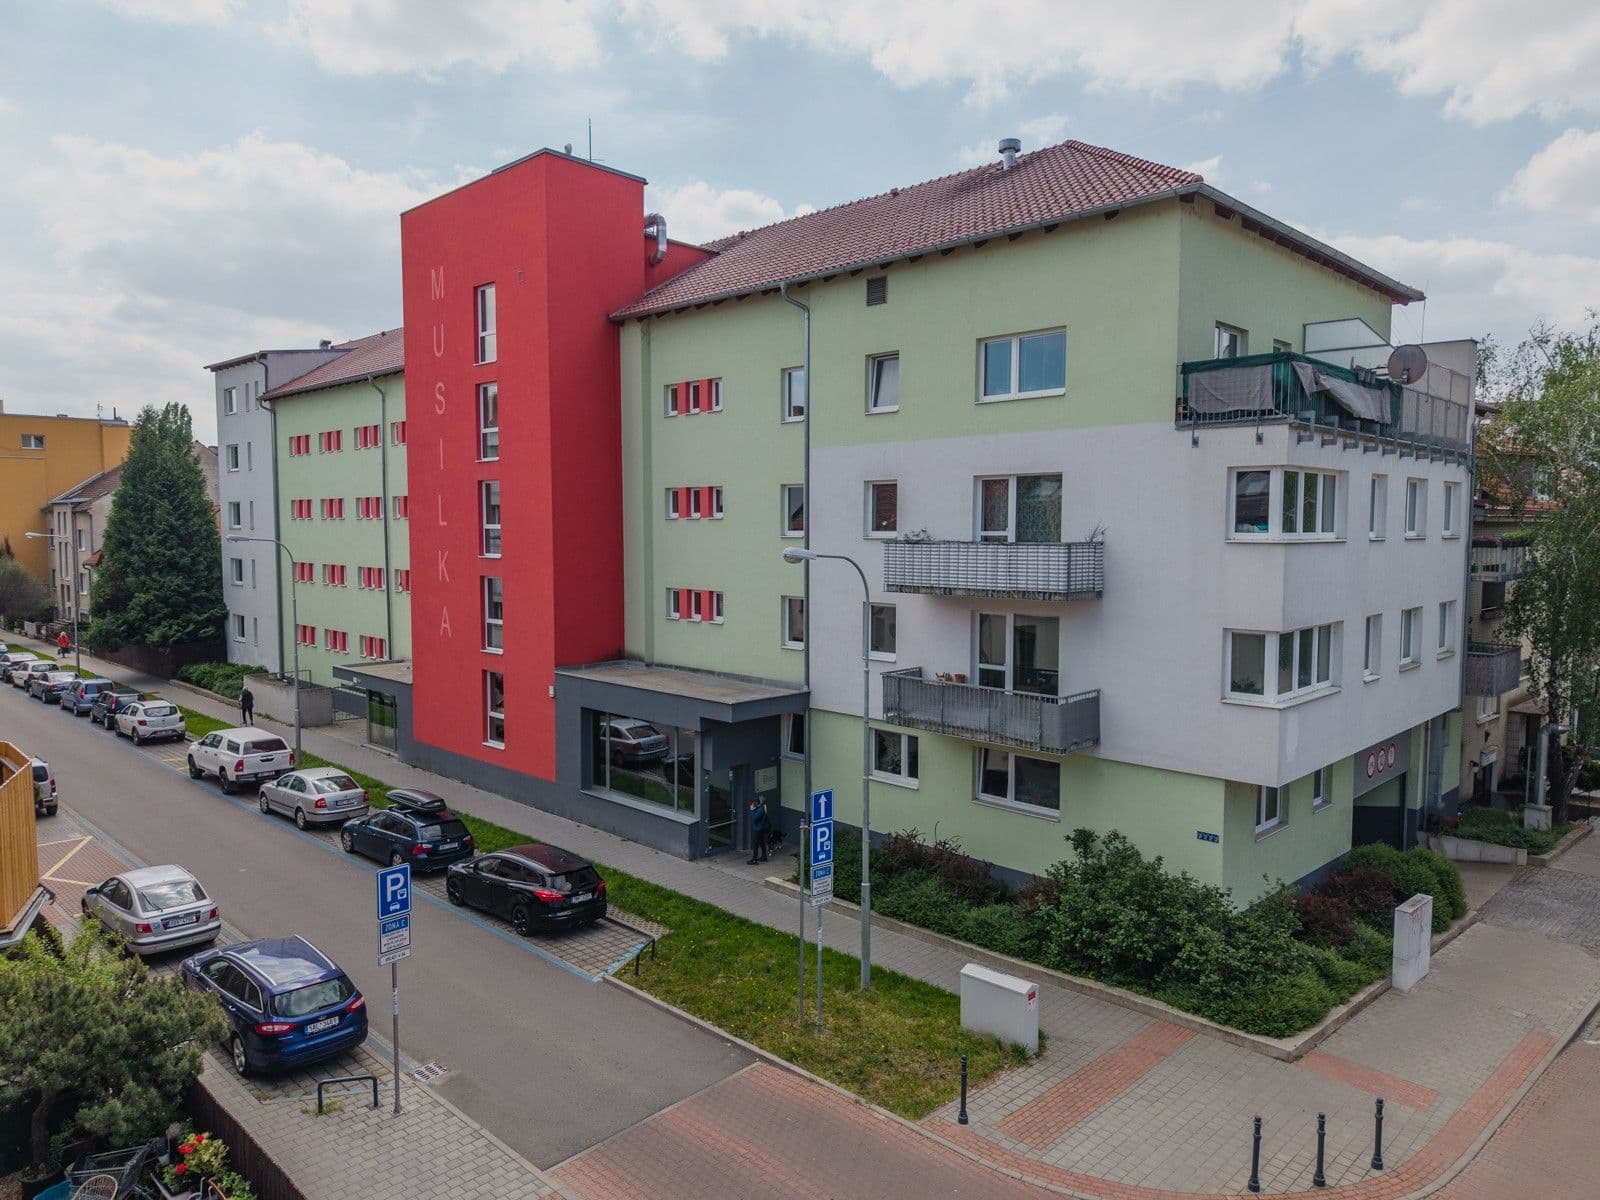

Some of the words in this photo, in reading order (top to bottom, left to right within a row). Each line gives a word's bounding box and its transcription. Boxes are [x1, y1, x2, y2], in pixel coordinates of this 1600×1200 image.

[431, 265, 452, 638] MUSILKA
[816, 827, 830, 852] P
[386, 873, 405, 903] P
[385, 922, 400, 932] ZONA
